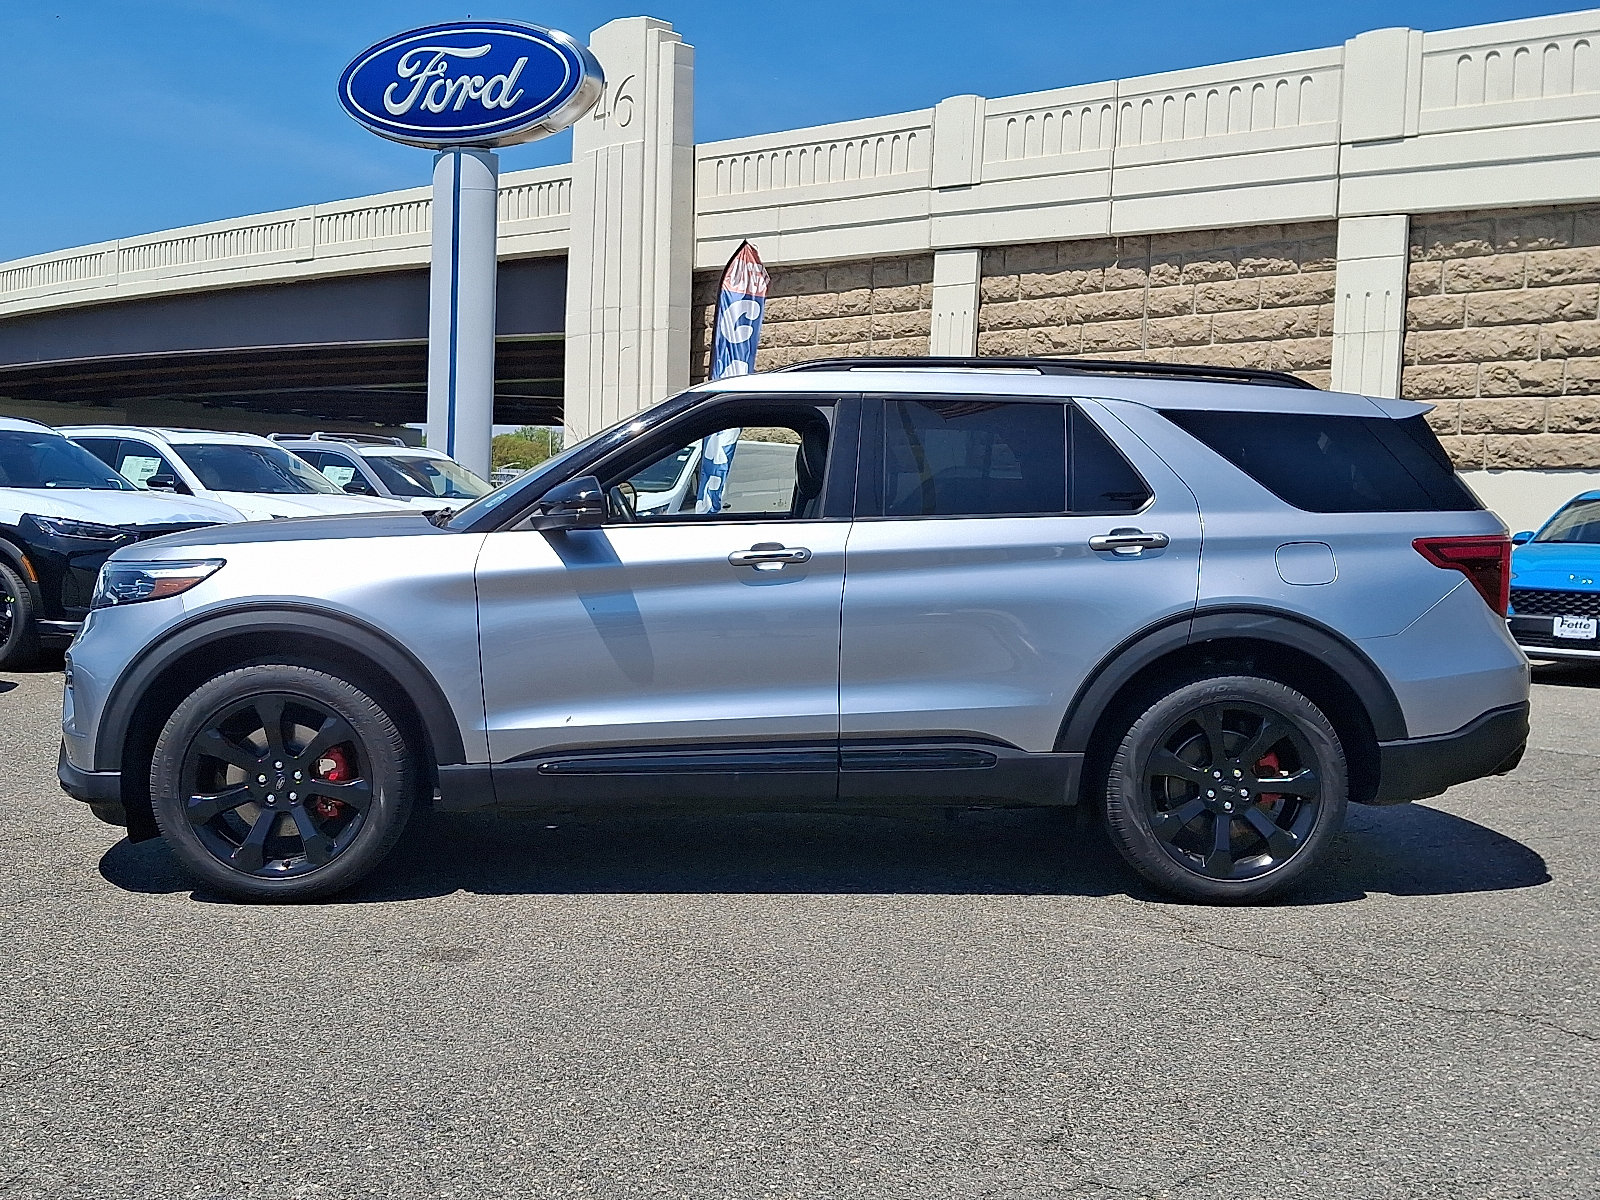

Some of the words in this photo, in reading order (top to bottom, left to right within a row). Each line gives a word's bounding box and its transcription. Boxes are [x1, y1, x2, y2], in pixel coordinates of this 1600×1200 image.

[384, 44, 528, 116] Ford
[594, 75, 635, 130] 46
[1560, 618, 1590, 629] Fette
